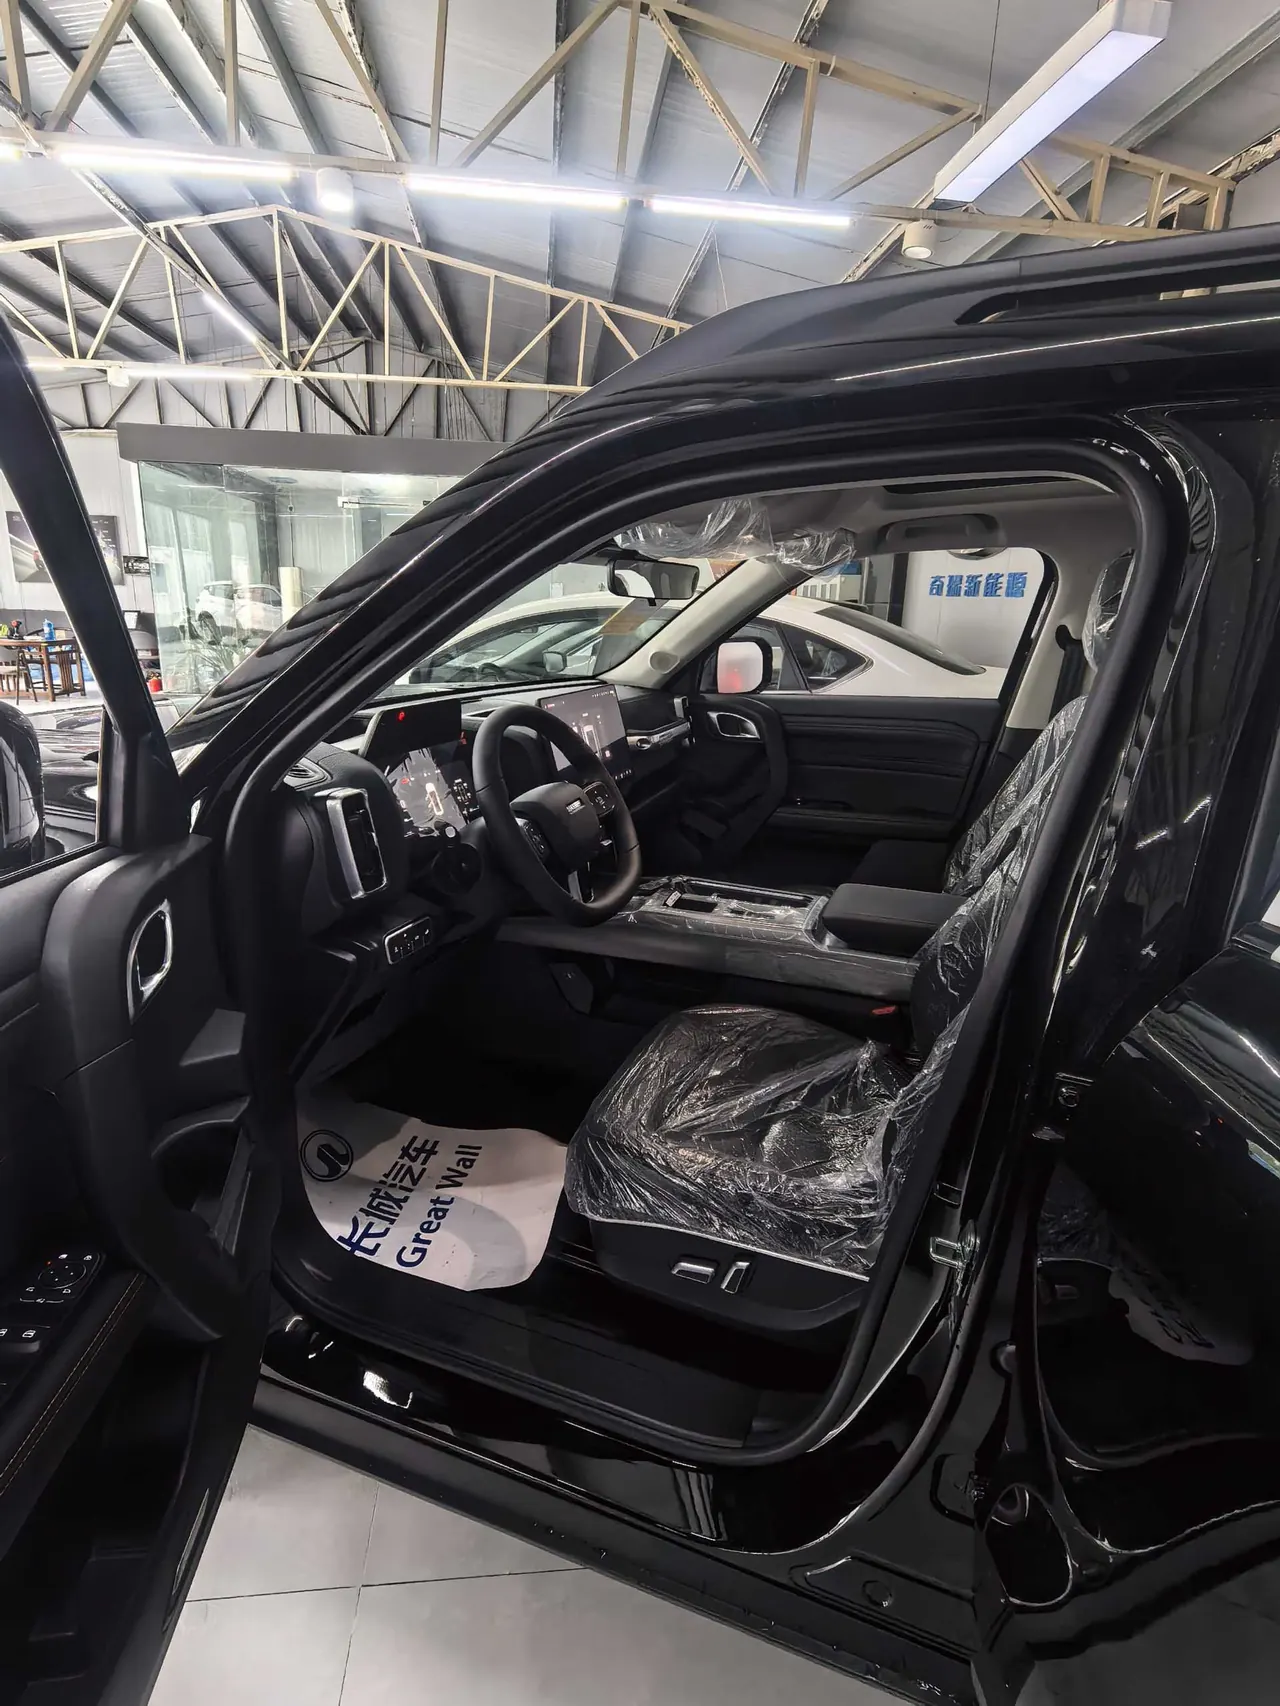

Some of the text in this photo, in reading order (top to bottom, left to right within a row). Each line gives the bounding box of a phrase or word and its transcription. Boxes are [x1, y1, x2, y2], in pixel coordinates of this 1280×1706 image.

[929, 572, 1027, 597] 奇瑞新能源
[337, 1135, 440, 1256] 长城汽车
[396, 1145, 482, 1268] Great Wall
